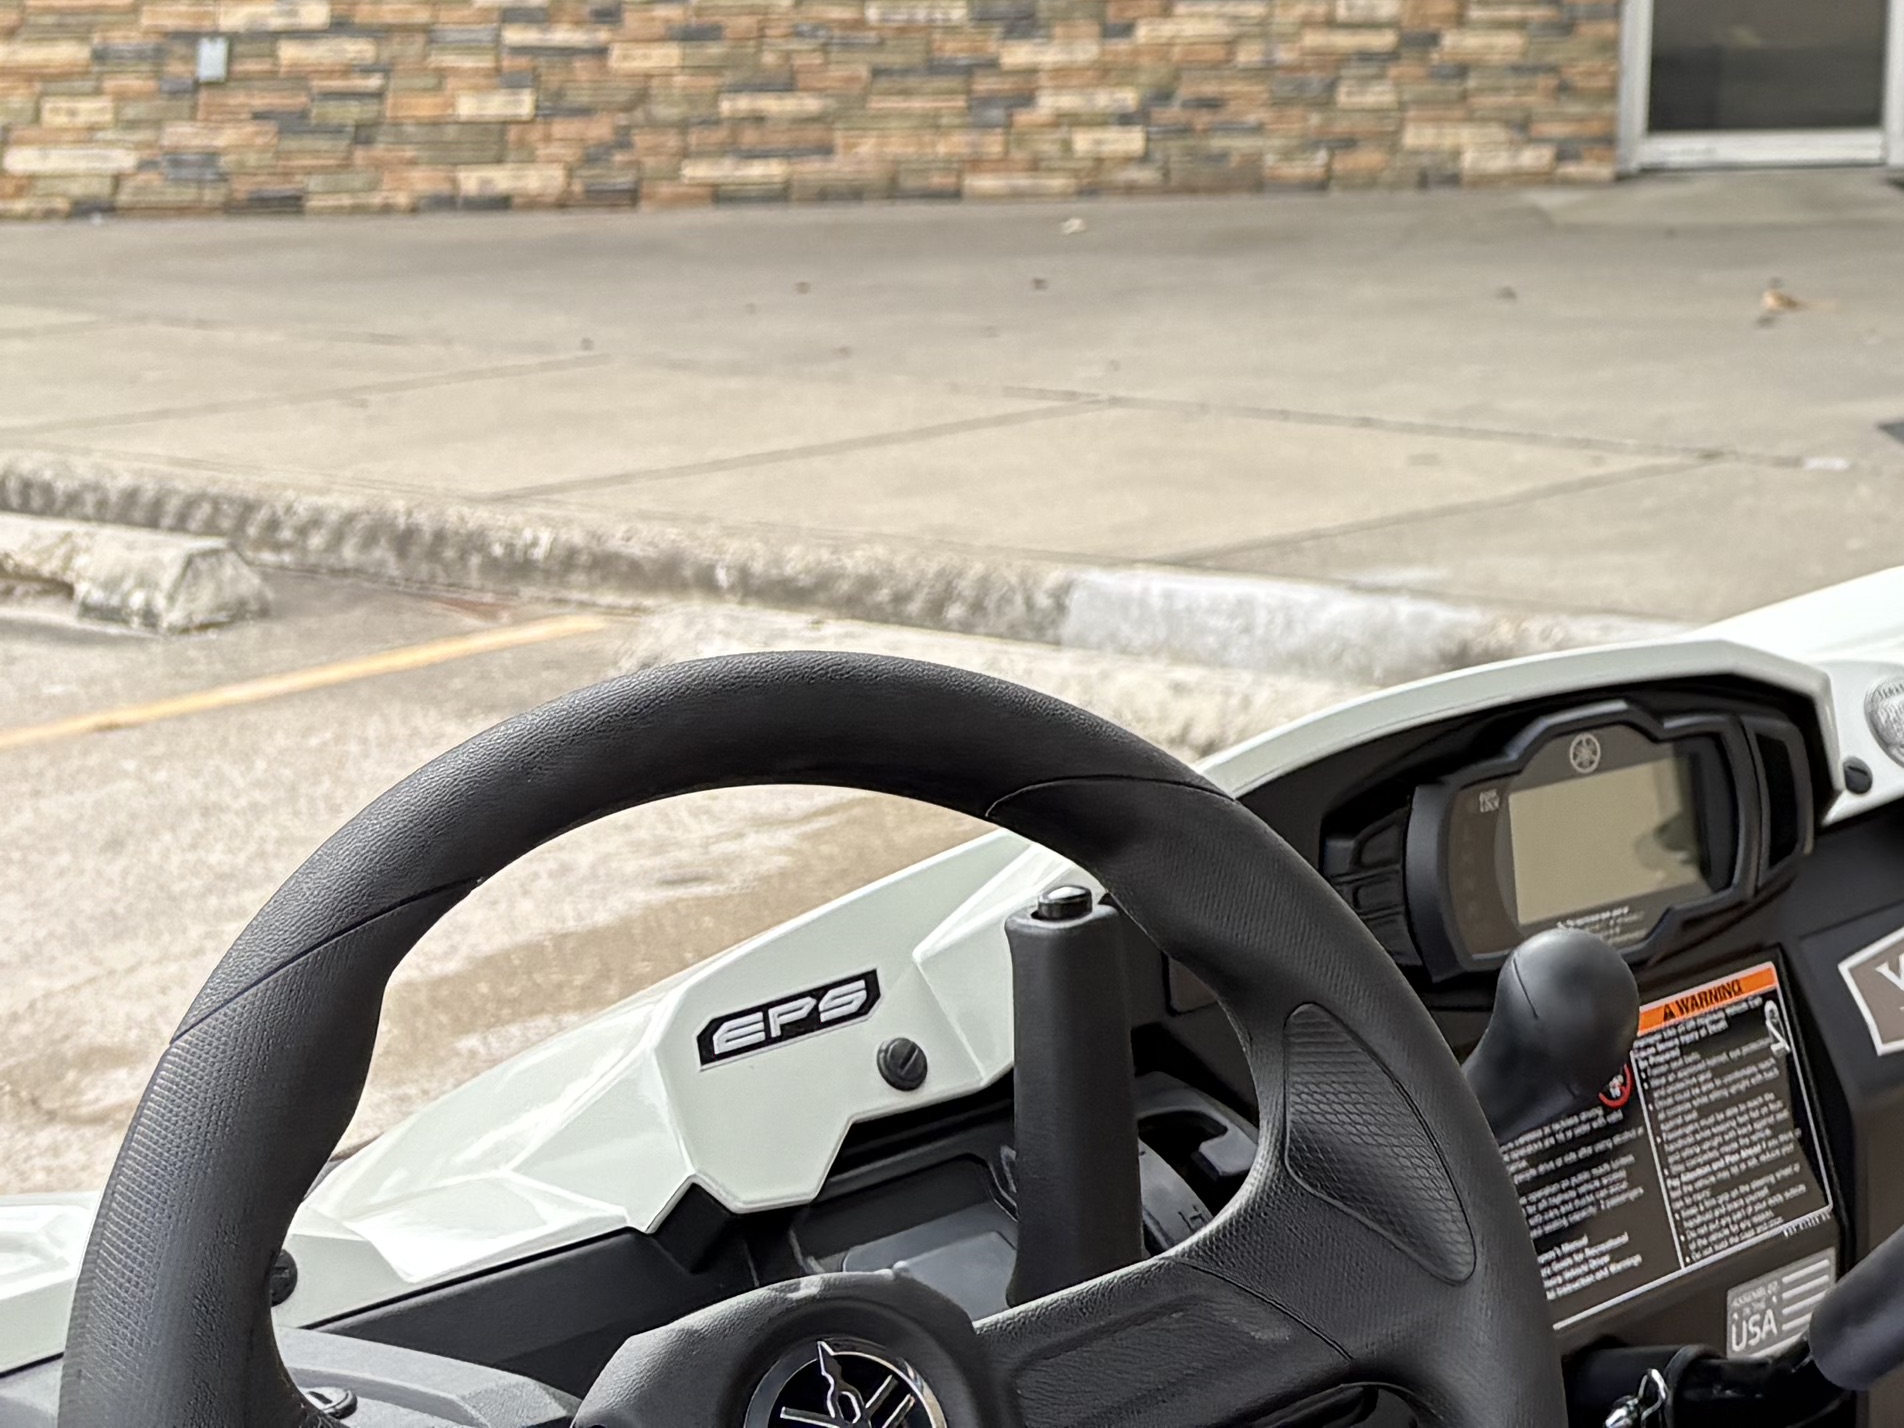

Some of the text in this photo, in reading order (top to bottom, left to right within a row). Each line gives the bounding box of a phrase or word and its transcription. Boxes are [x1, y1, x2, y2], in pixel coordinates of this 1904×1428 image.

[712, 979, 868, 1055] EPS
[1675, 979, 1744, 1016] WARNING
[1732, 1309, 1778, 1352] USA
